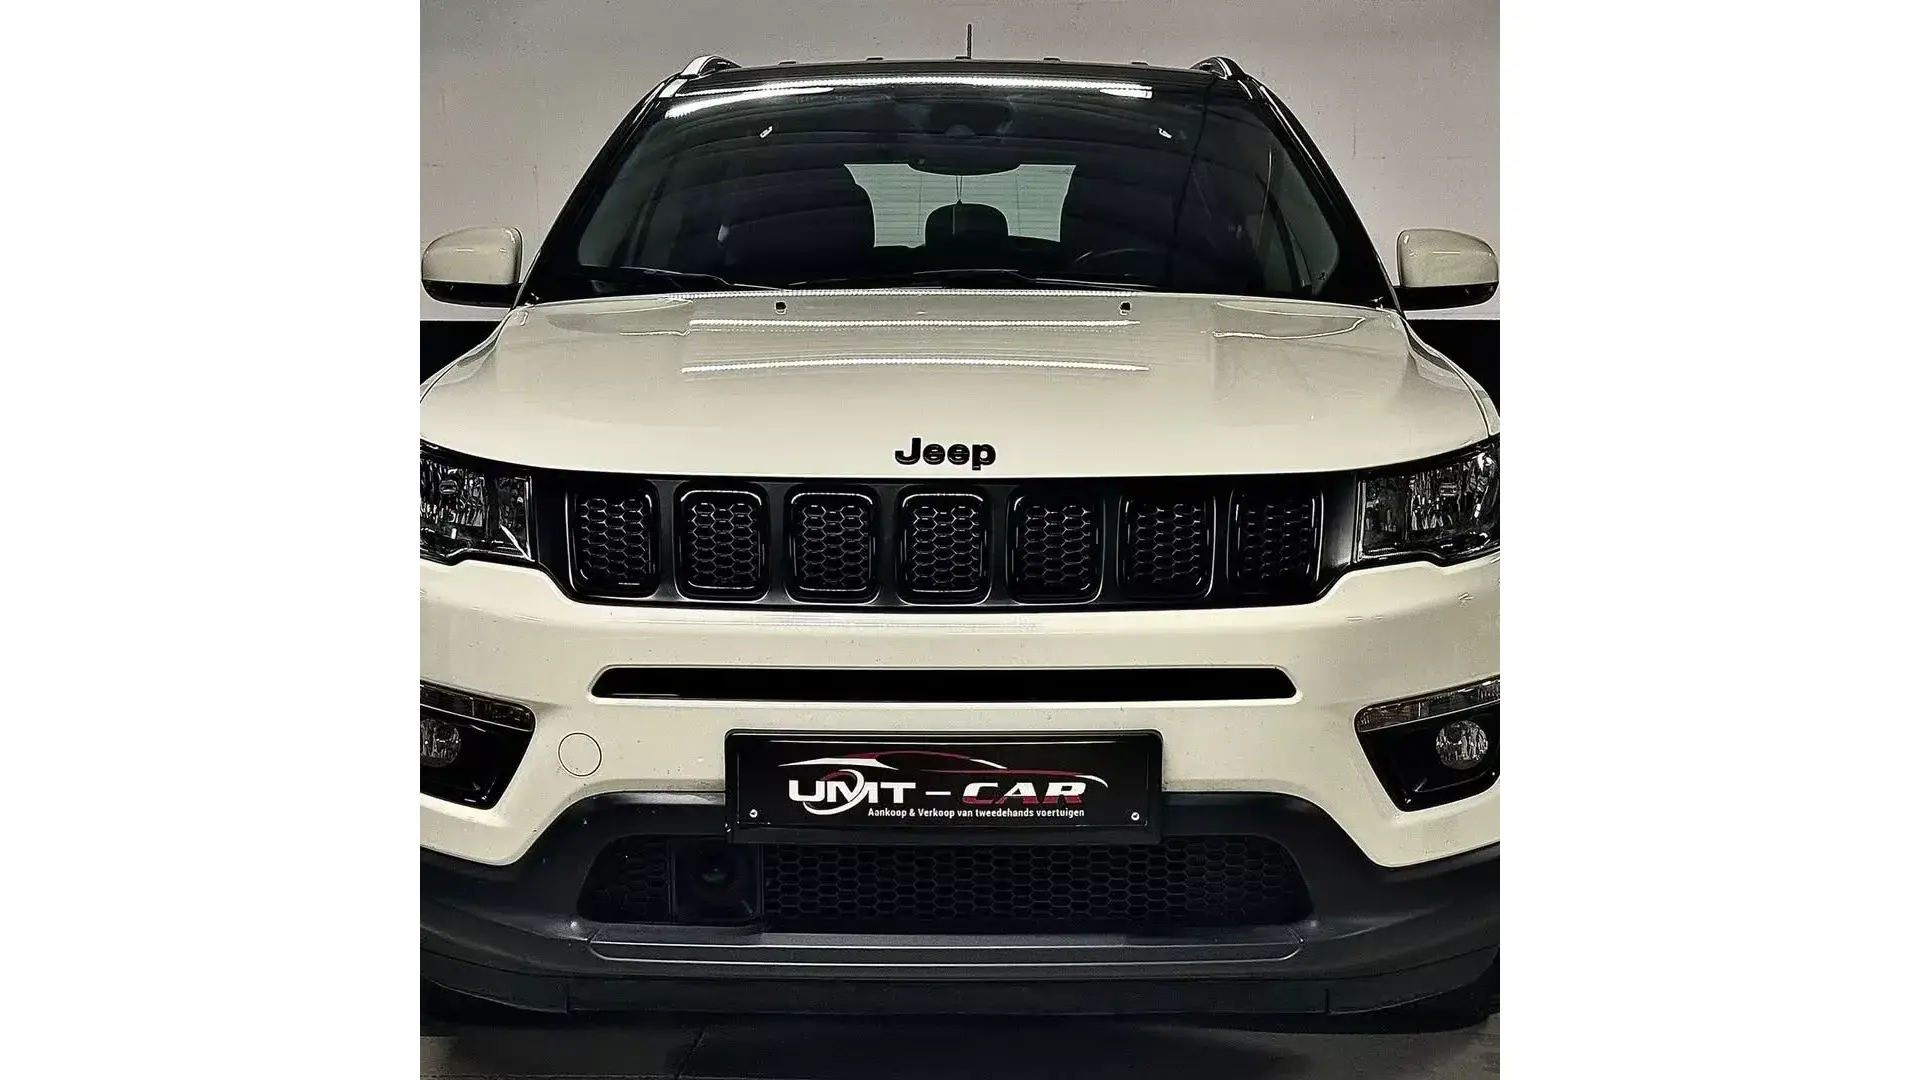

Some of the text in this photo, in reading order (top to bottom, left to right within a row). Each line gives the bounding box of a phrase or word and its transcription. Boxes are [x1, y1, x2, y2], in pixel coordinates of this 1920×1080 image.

[895, 437, 997, 471] Jeep
[788, 777, 917, 806] UMT
[962, 782, 1087, 805] CAR
[867, 807, 1086, 819] Aankoop & Verkoop van tweedehands voertuigen
